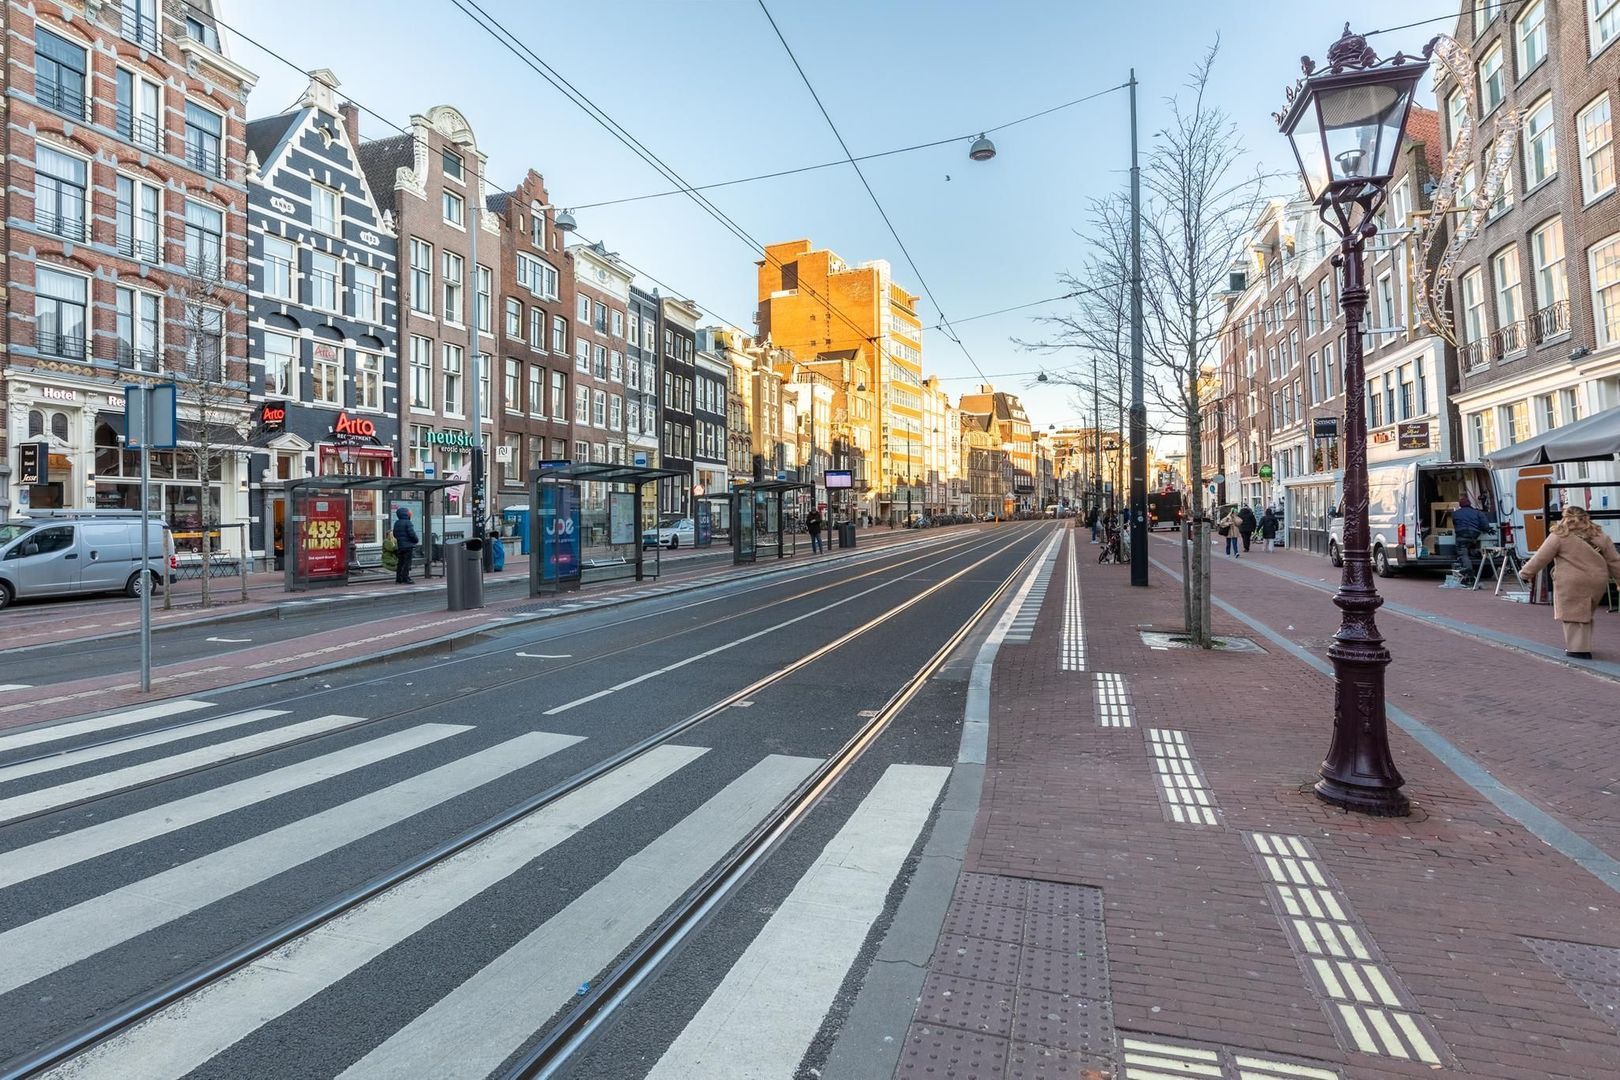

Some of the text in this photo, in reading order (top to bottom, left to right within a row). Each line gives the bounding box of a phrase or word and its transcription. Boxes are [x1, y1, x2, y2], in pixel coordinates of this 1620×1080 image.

[274, 199, 292, 211] ANNO
[43, 387, 76, 400] Hotel
[263, 407, 285, 420] Arto
[336, 411, 375, 436] Arto
